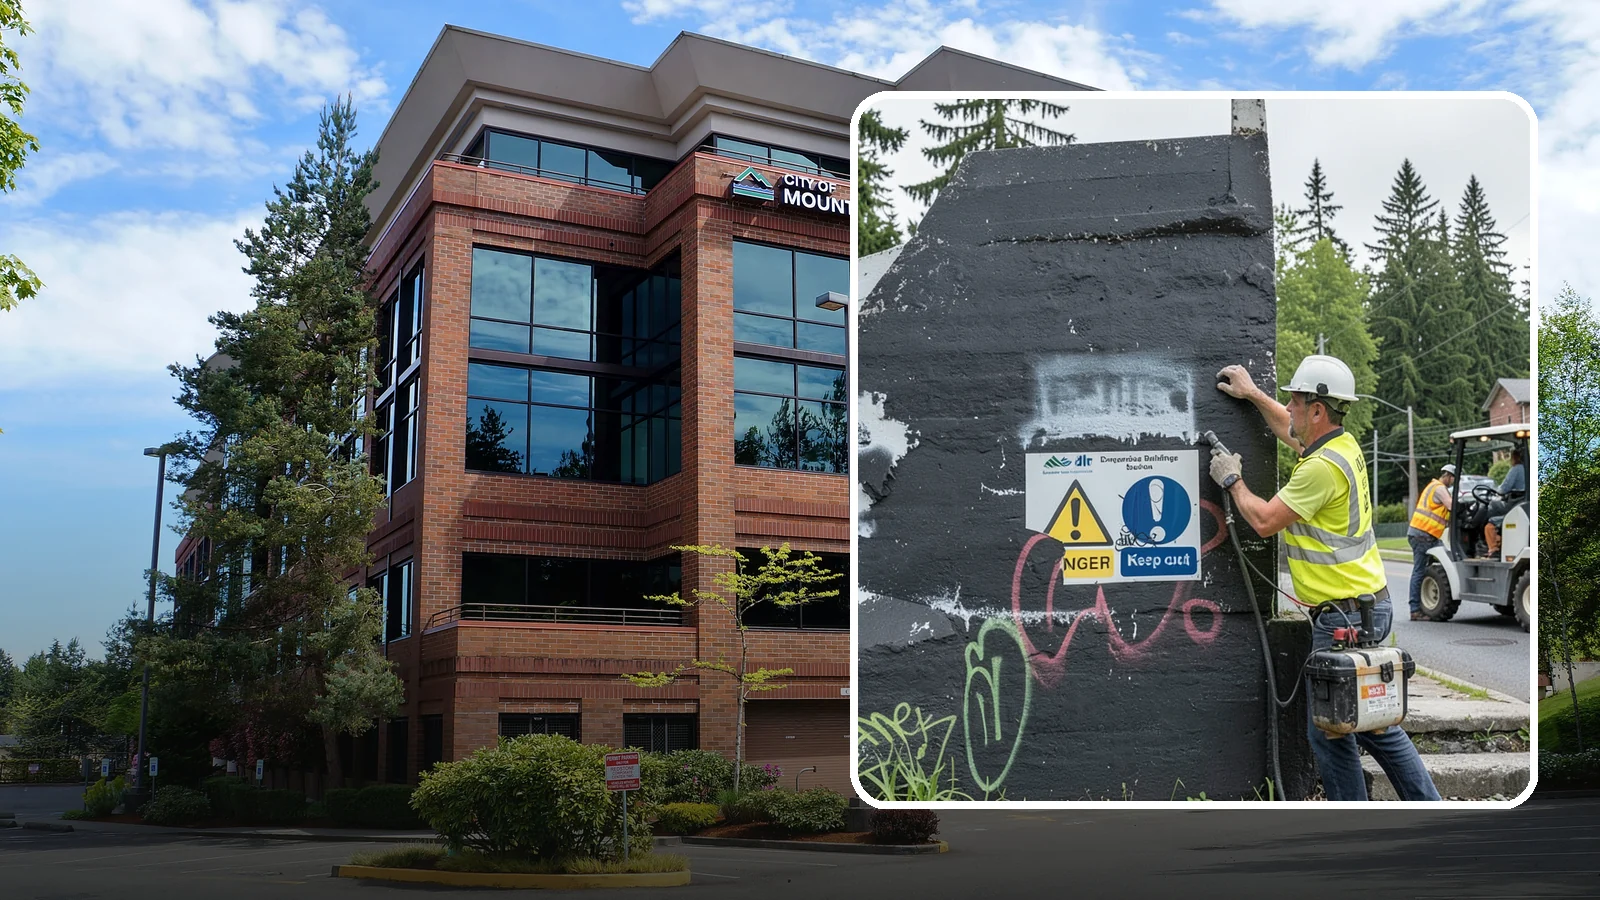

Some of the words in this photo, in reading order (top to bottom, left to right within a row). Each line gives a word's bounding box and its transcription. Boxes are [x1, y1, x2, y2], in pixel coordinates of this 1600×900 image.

[784, 174, 815, 190] CITY
[818, 180, 836, 193] OF
[1064, 556, 1110, 571] NGER
[1127, 553, 1161, 569] Keep
